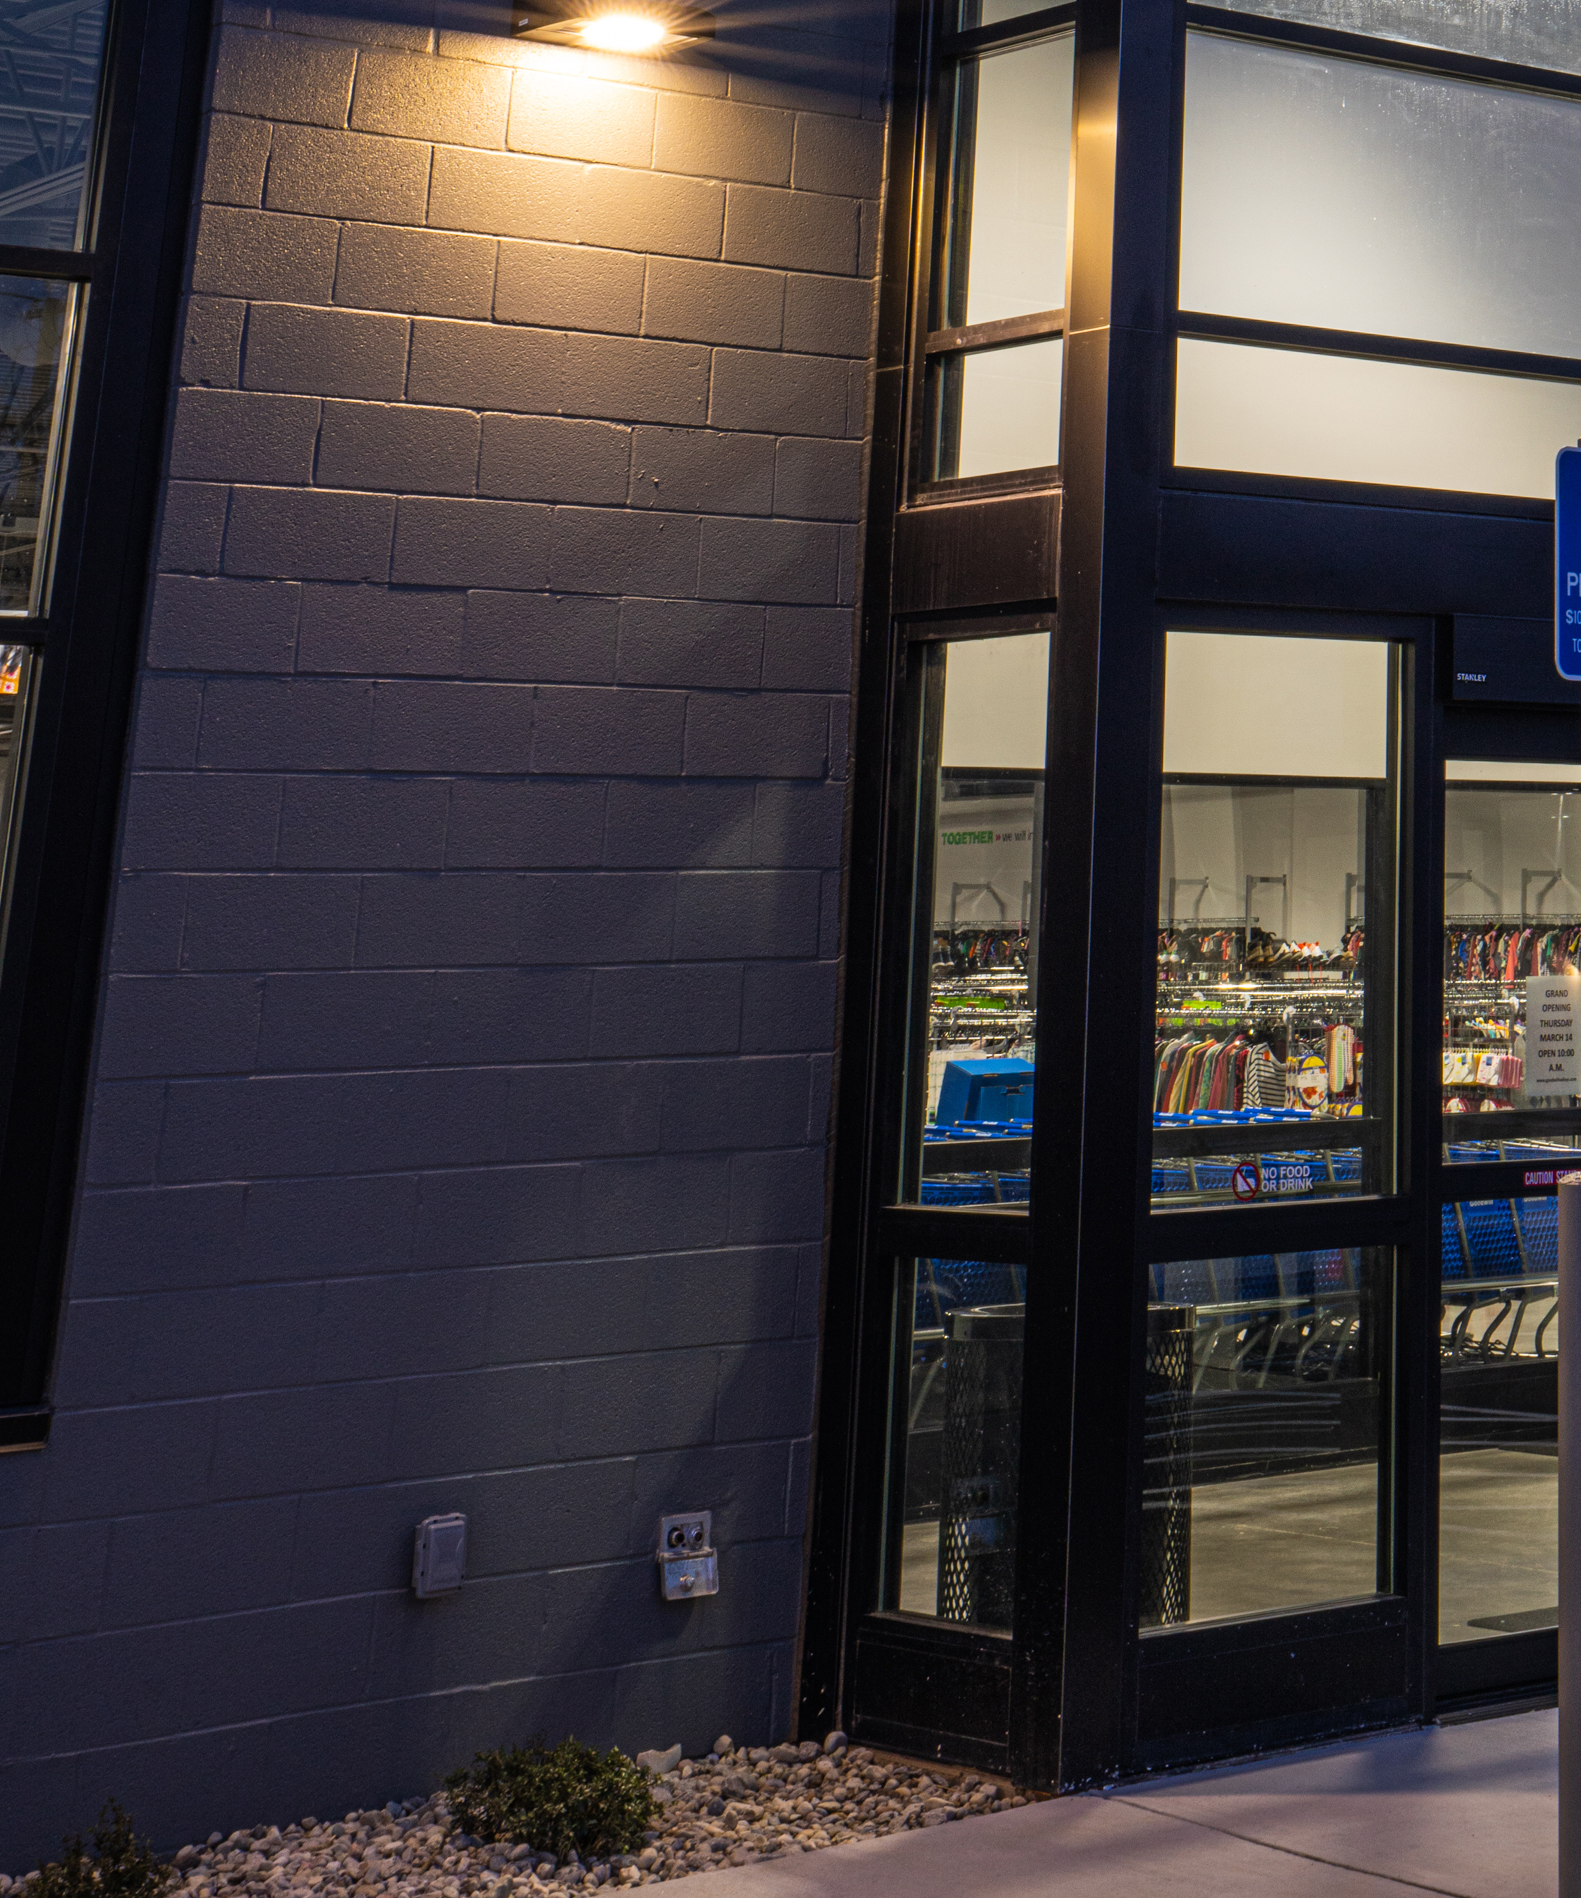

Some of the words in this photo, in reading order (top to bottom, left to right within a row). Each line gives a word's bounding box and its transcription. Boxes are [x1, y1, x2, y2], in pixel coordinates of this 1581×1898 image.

[1457, 673, 1487, 682] STANLEY
[941, 830, 994, 845] TOGETHER
[1545, 989, 1569, 998] GRAND
[1542, 1003, 1571, 1012] OPENING
[1540, 1019, 1573, 1028] THURSDAY
[1540, 1033, 1564, 1042] MARCH
[1565, 1033, 1573, 1042] 14
[1538, 1049, 1556, 1058] OPEN
[1557, 1048, 1575, 1057] 10:00
[1548, 1063, 1565, 1072] A.M.
[1262, 1167, 1277, 1179] NO
[1280, 1165, 1311, 1178] FOOD
[1525, 1171, 1554, 1185] CAUTION
[1261, 1180, 1277, 1192] OR
[1280, 1177, 1314, 1191] DRINK
